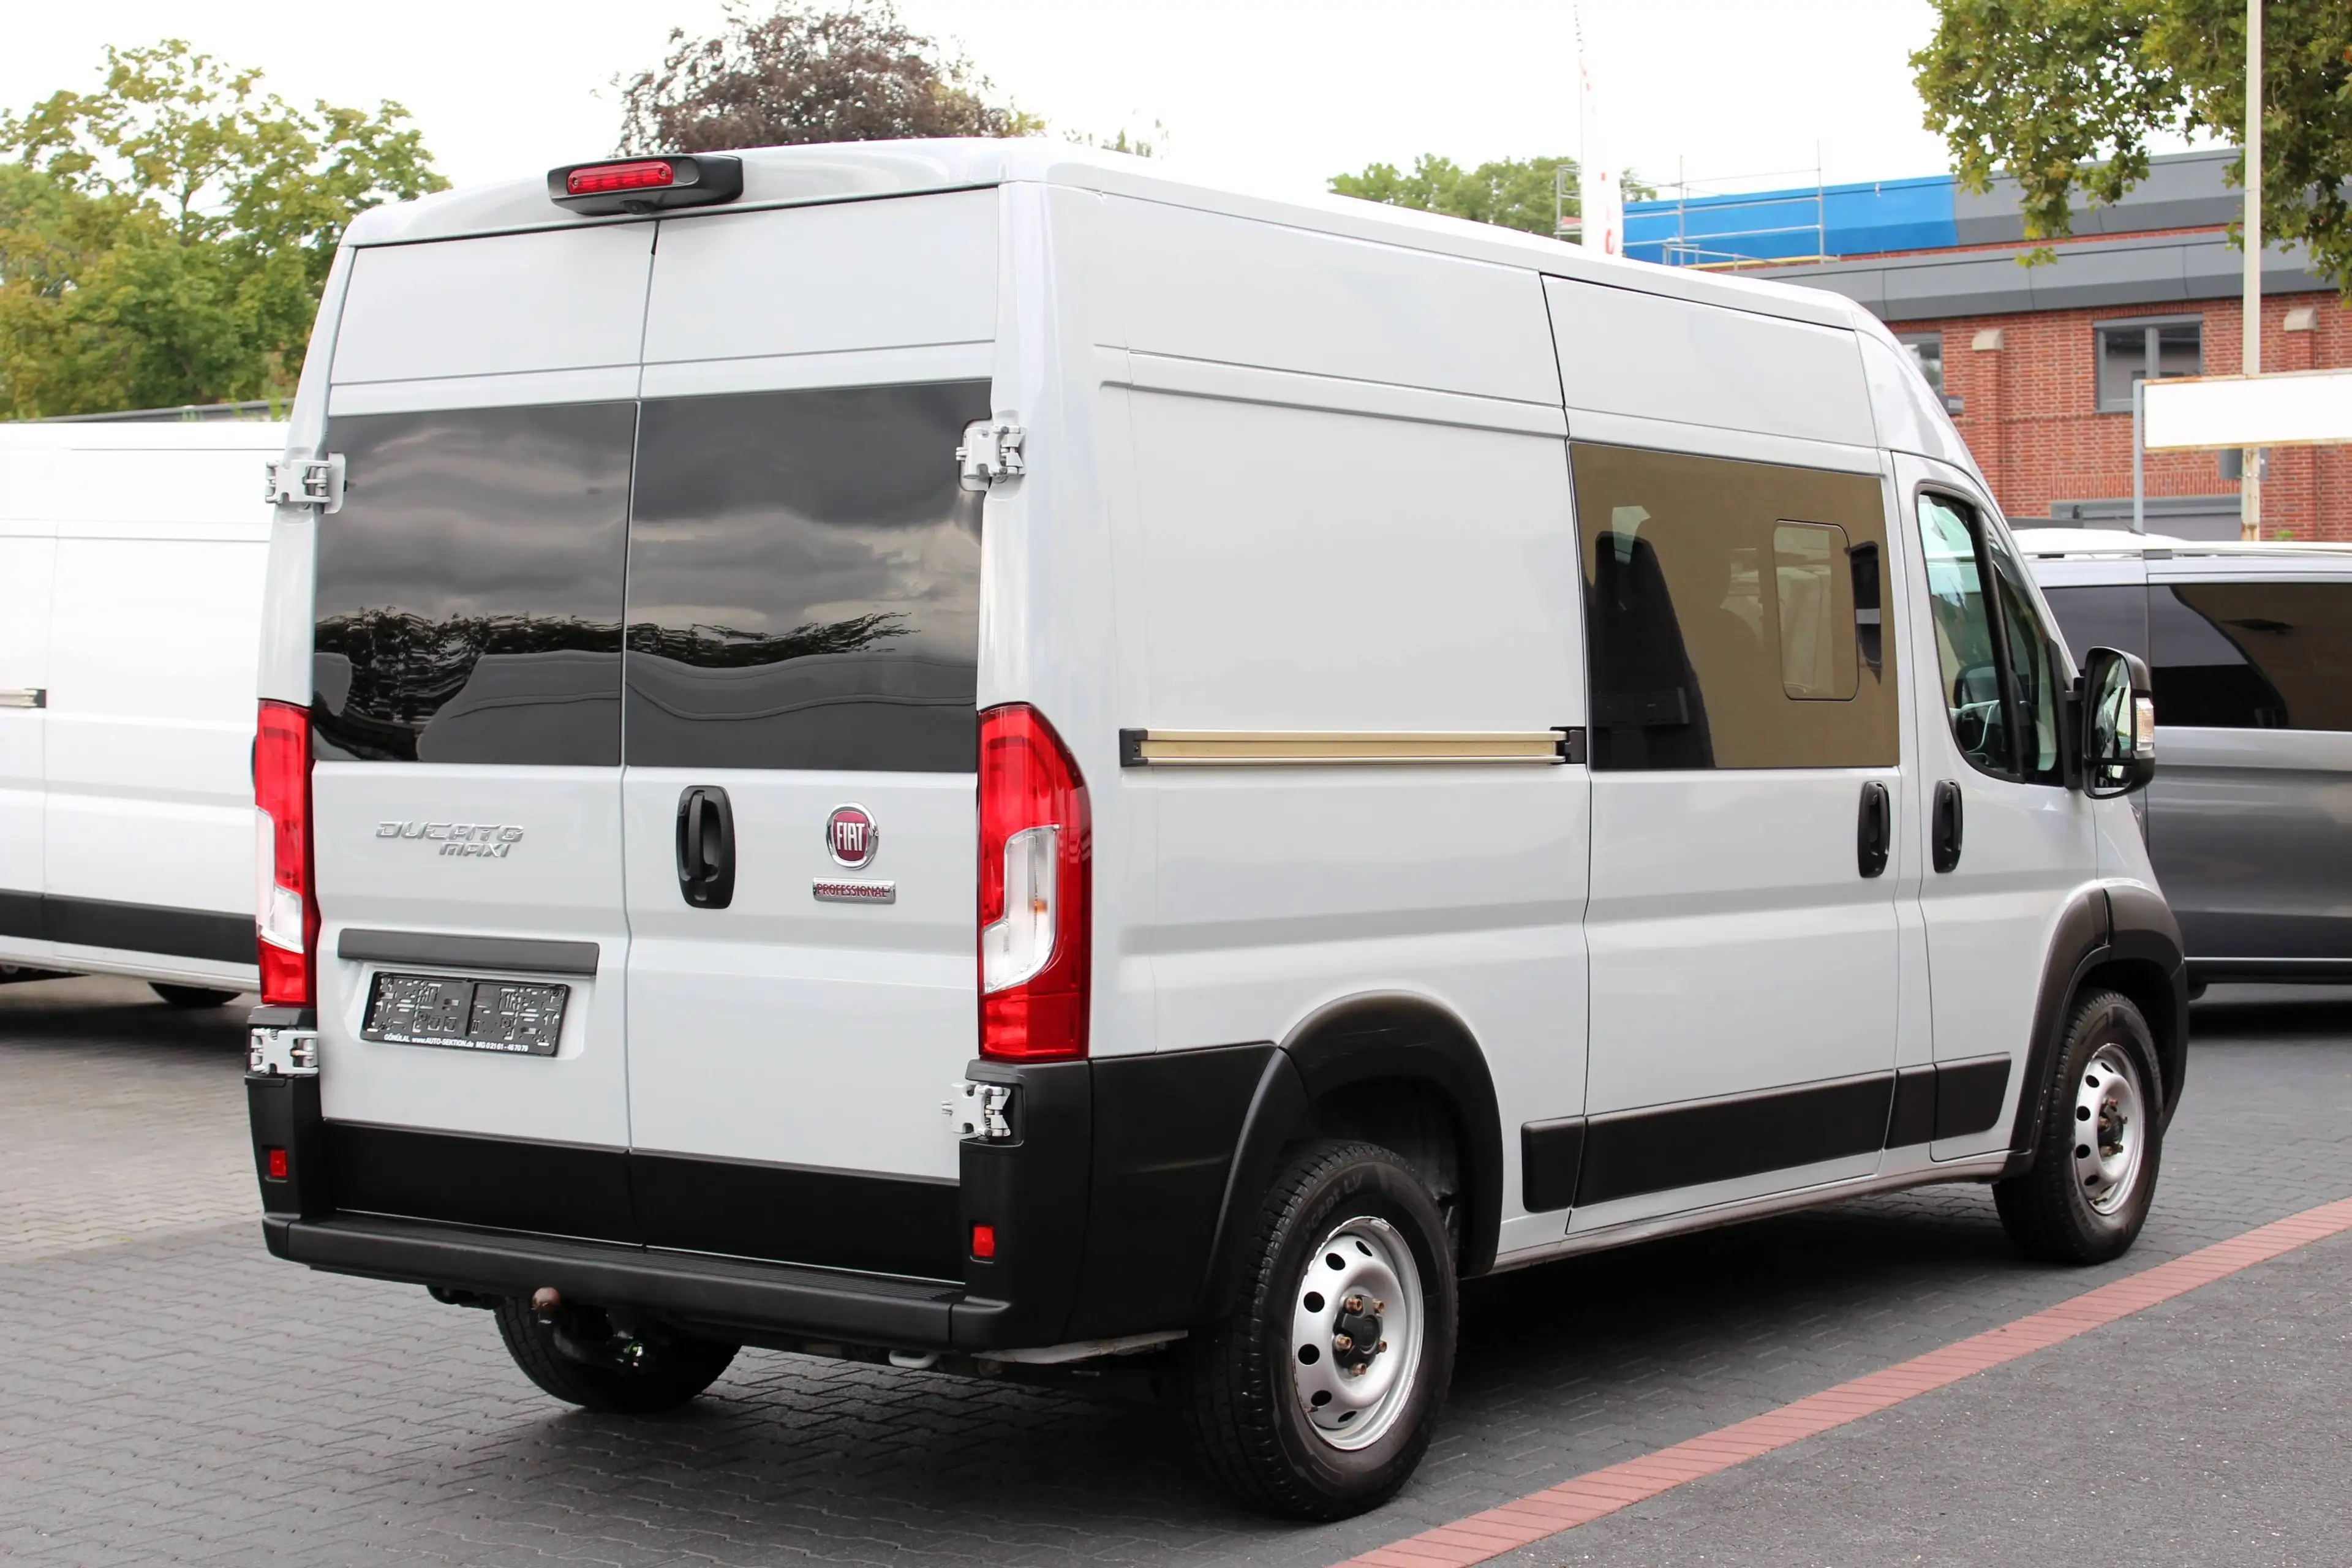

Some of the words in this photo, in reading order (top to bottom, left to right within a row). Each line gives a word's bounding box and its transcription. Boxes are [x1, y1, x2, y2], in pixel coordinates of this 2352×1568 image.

[375, 821, 524, 842] DUCATO
[836, 822, 865, 851] FIAT
[439, 842, 511, 858] MAXI
[816, 883, 888, 898] PROFESSIONAL
